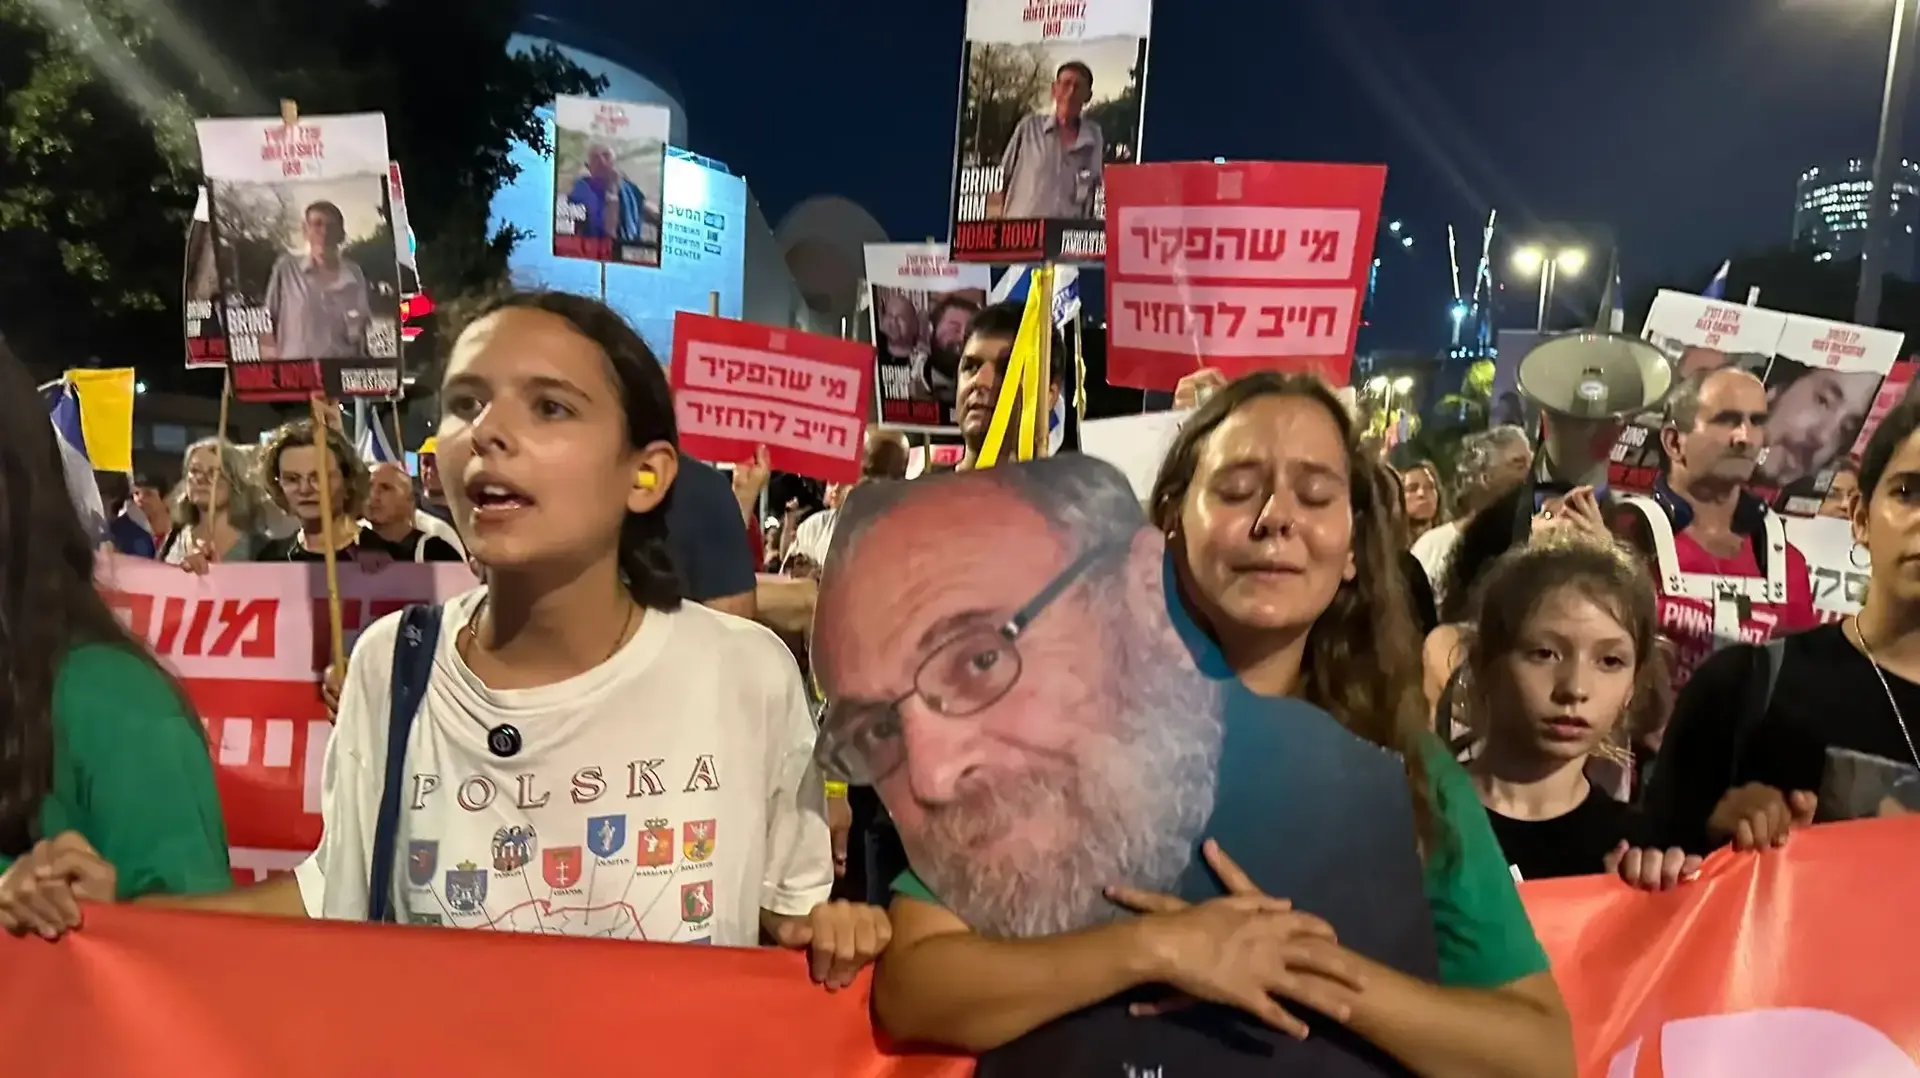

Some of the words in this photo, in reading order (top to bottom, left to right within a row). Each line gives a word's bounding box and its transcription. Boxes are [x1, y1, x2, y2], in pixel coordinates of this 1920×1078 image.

[960, 165, 1005, 196] BRING
[957, 193, 987, 222] HIM
[1130, 226, 1287, 265] שהפקיר
[1300, 229, 1340, 262] מי
[1257, 305, 1338, 338] חייב
[699, 355, 813, 391] שהפקיר
[820, 374, 848, 399] מי
[686, 400, 786, 434] להחזיר
[793, 417, 848, 447] חייב
[1619, 426, 1648, 447] RING
[411, 754, 720, 812] POLSKA
